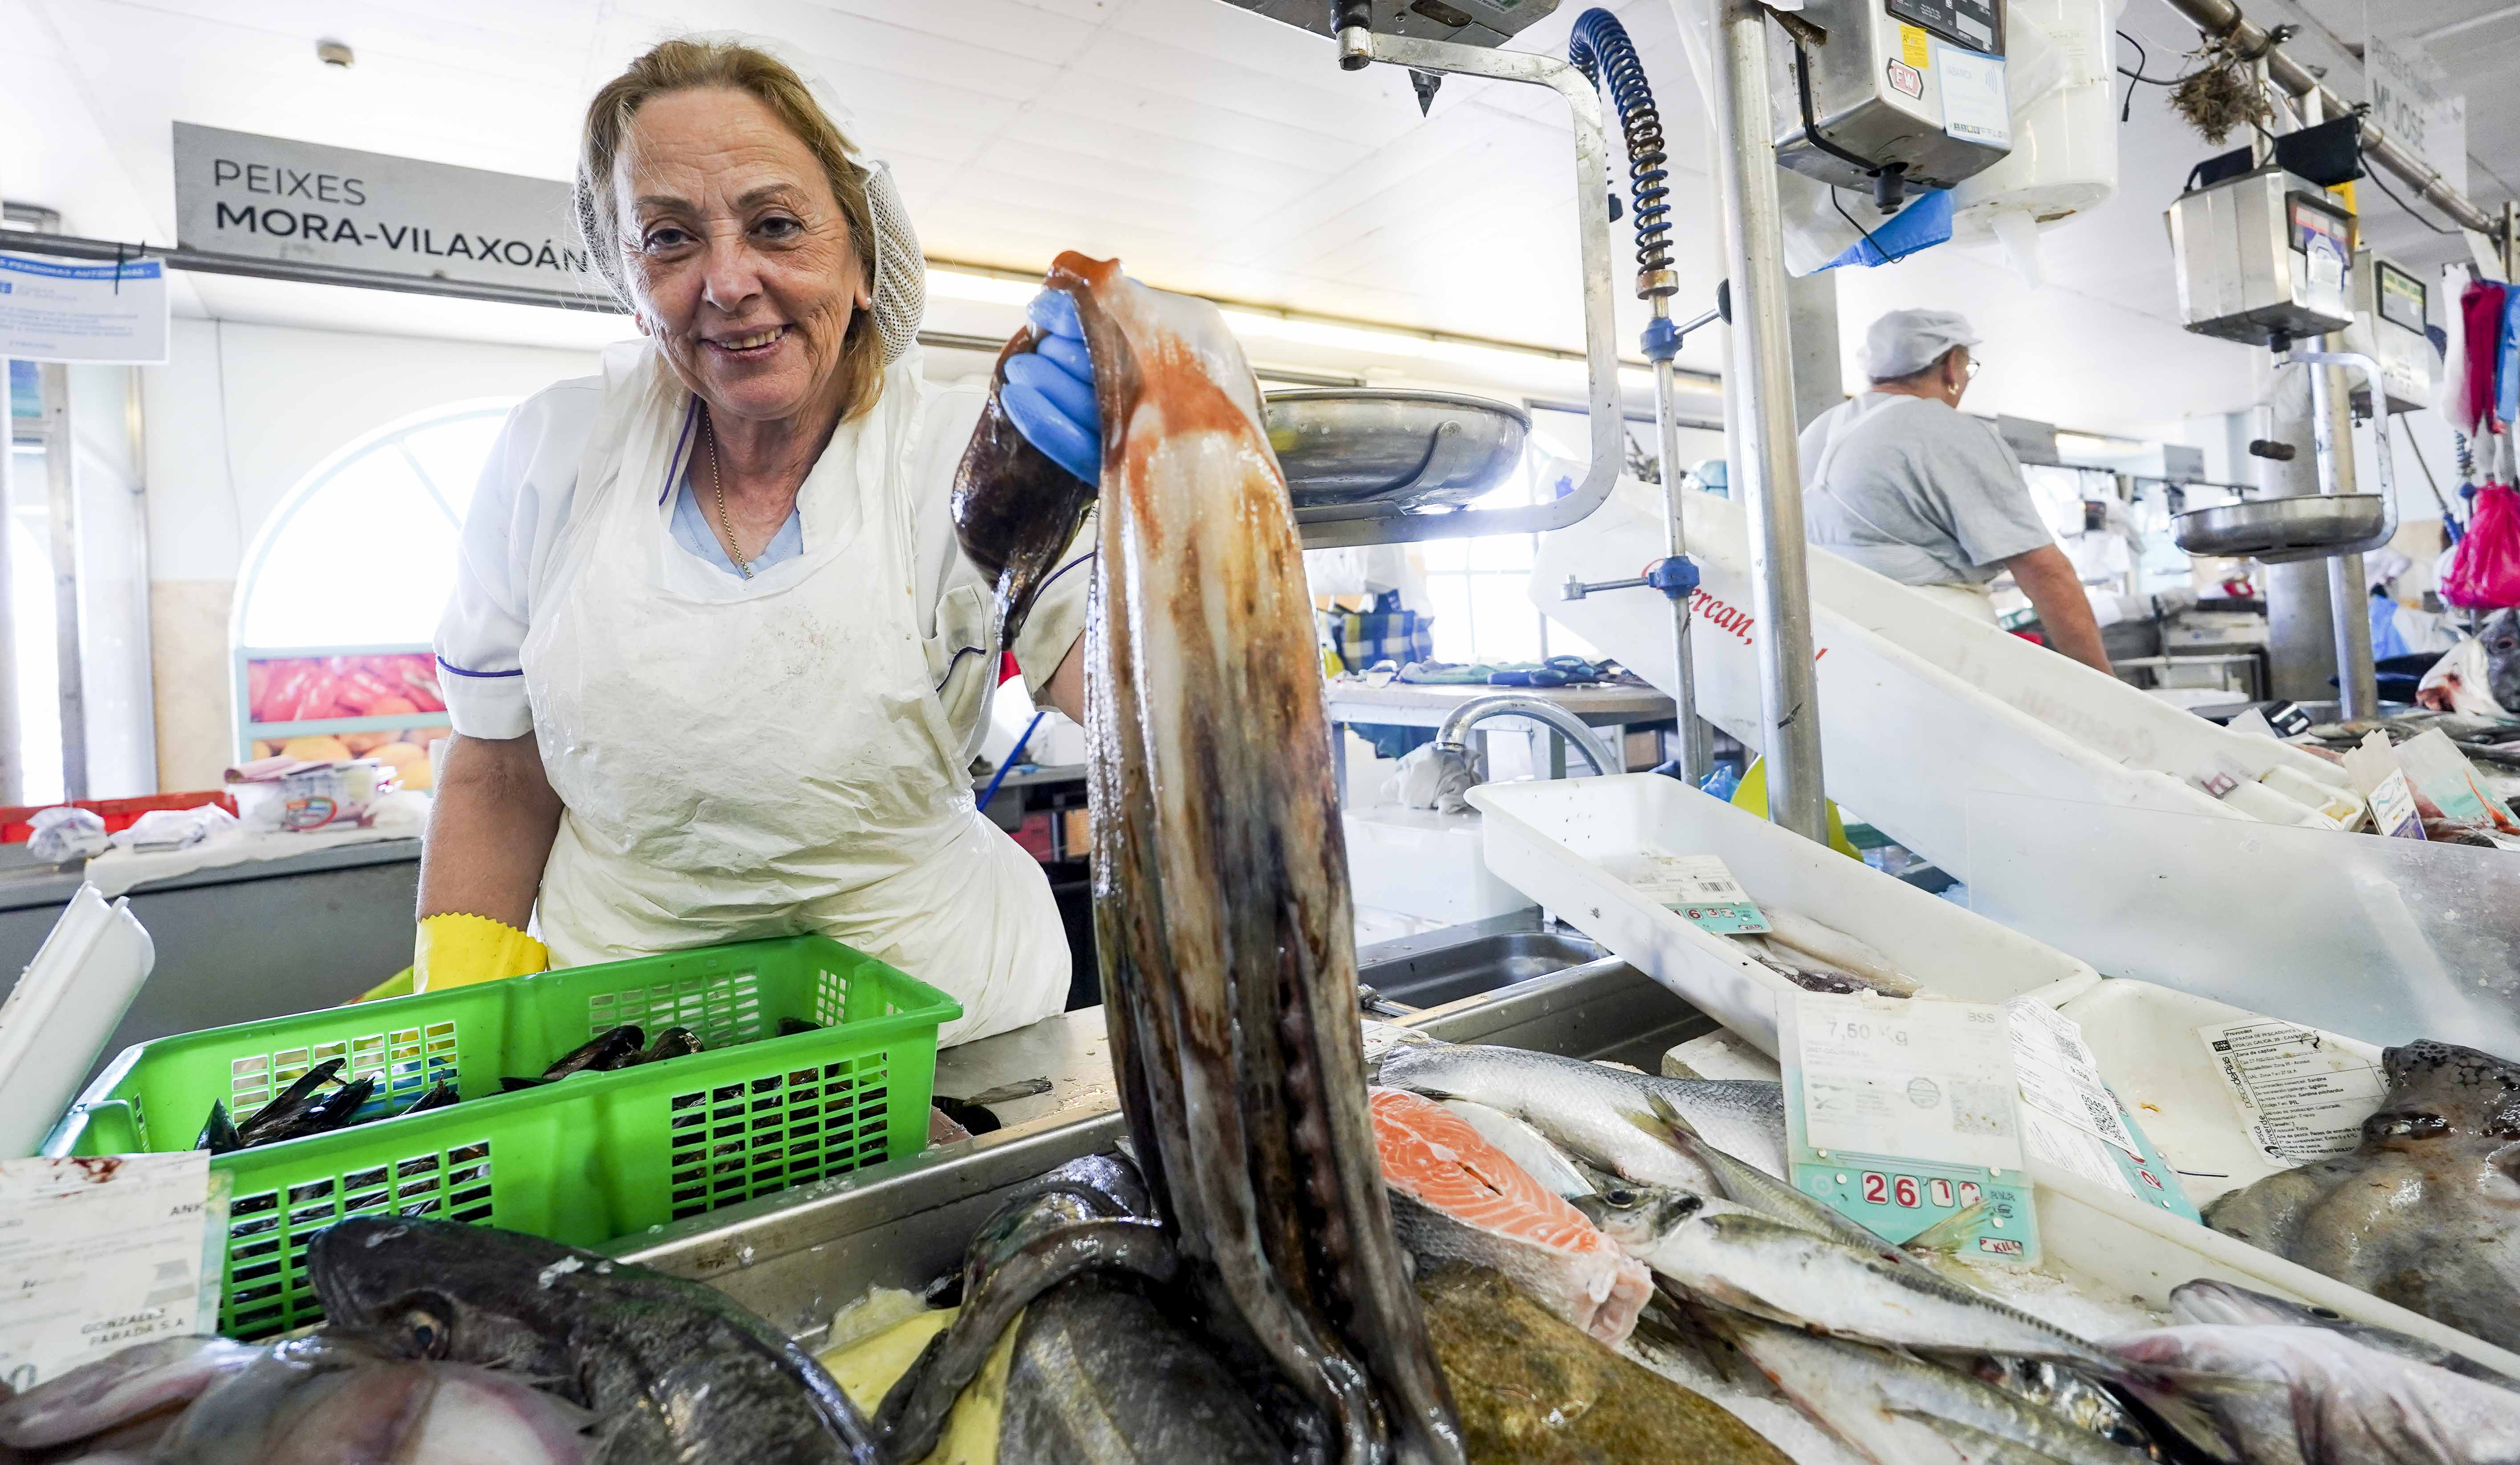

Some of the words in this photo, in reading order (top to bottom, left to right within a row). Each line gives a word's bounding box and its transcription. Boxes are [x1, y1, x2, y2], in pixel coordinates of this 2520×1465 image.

[1896, 68, 1914, 90] FW
[214, 158, 366, 207] PEIXES
[216, 201, 590, 272] MORA-VILAXOÁN
[1968, 1012, 1995, 1024] BSS
[1826, 1022, 1870, 1040] 7,50
[2253, 1126, 2268, 1145] pesca
